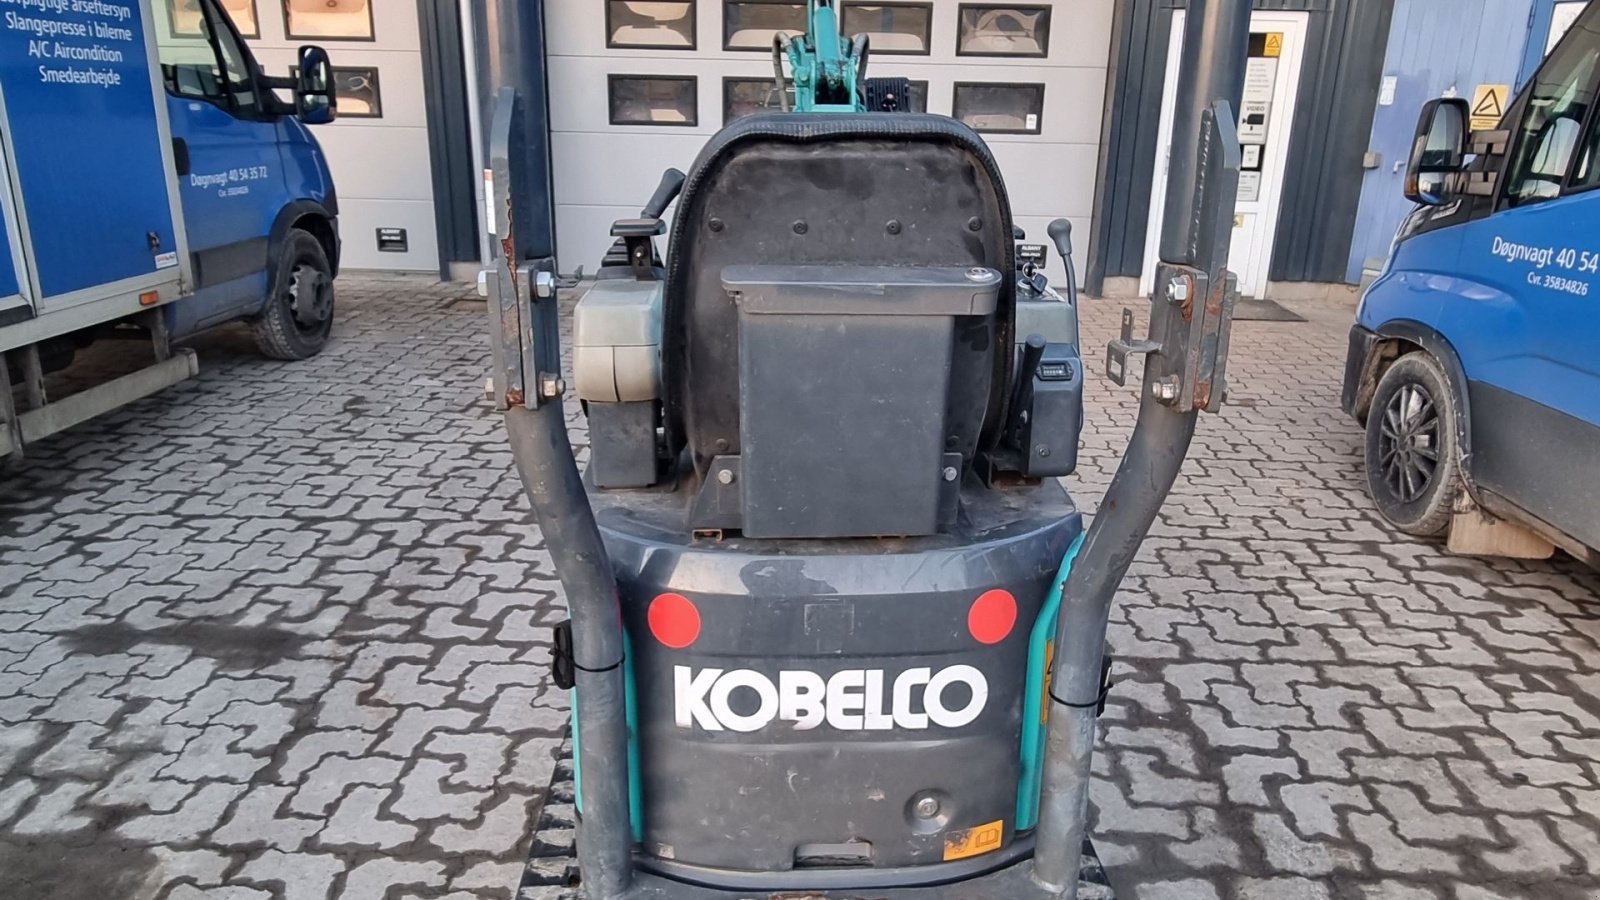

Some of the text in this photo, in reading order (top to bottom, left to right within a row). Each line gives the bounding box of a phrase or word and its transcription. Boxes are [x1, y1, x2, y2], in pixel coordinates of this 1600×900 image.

[1, 0, 69, 14] pgtige
[5, 12, 133, 41] Slangepresse i bilerne
[28, 40, 123, 63] A/C Aircondition
[39, 65, 121, 88] Smedearbejde
[229, 169, 239, 181] 40
[239, 168, 249, 181] 54
[249, 167, 258, 179] 35
[259, 166, 268, 178] 72
[1492, 236, 1600, 274] Døgnvagt 40 54
[1527, 271, 1589, 296] Cvr. 35834826
[673, 664, 989, 732] KOBELCO
